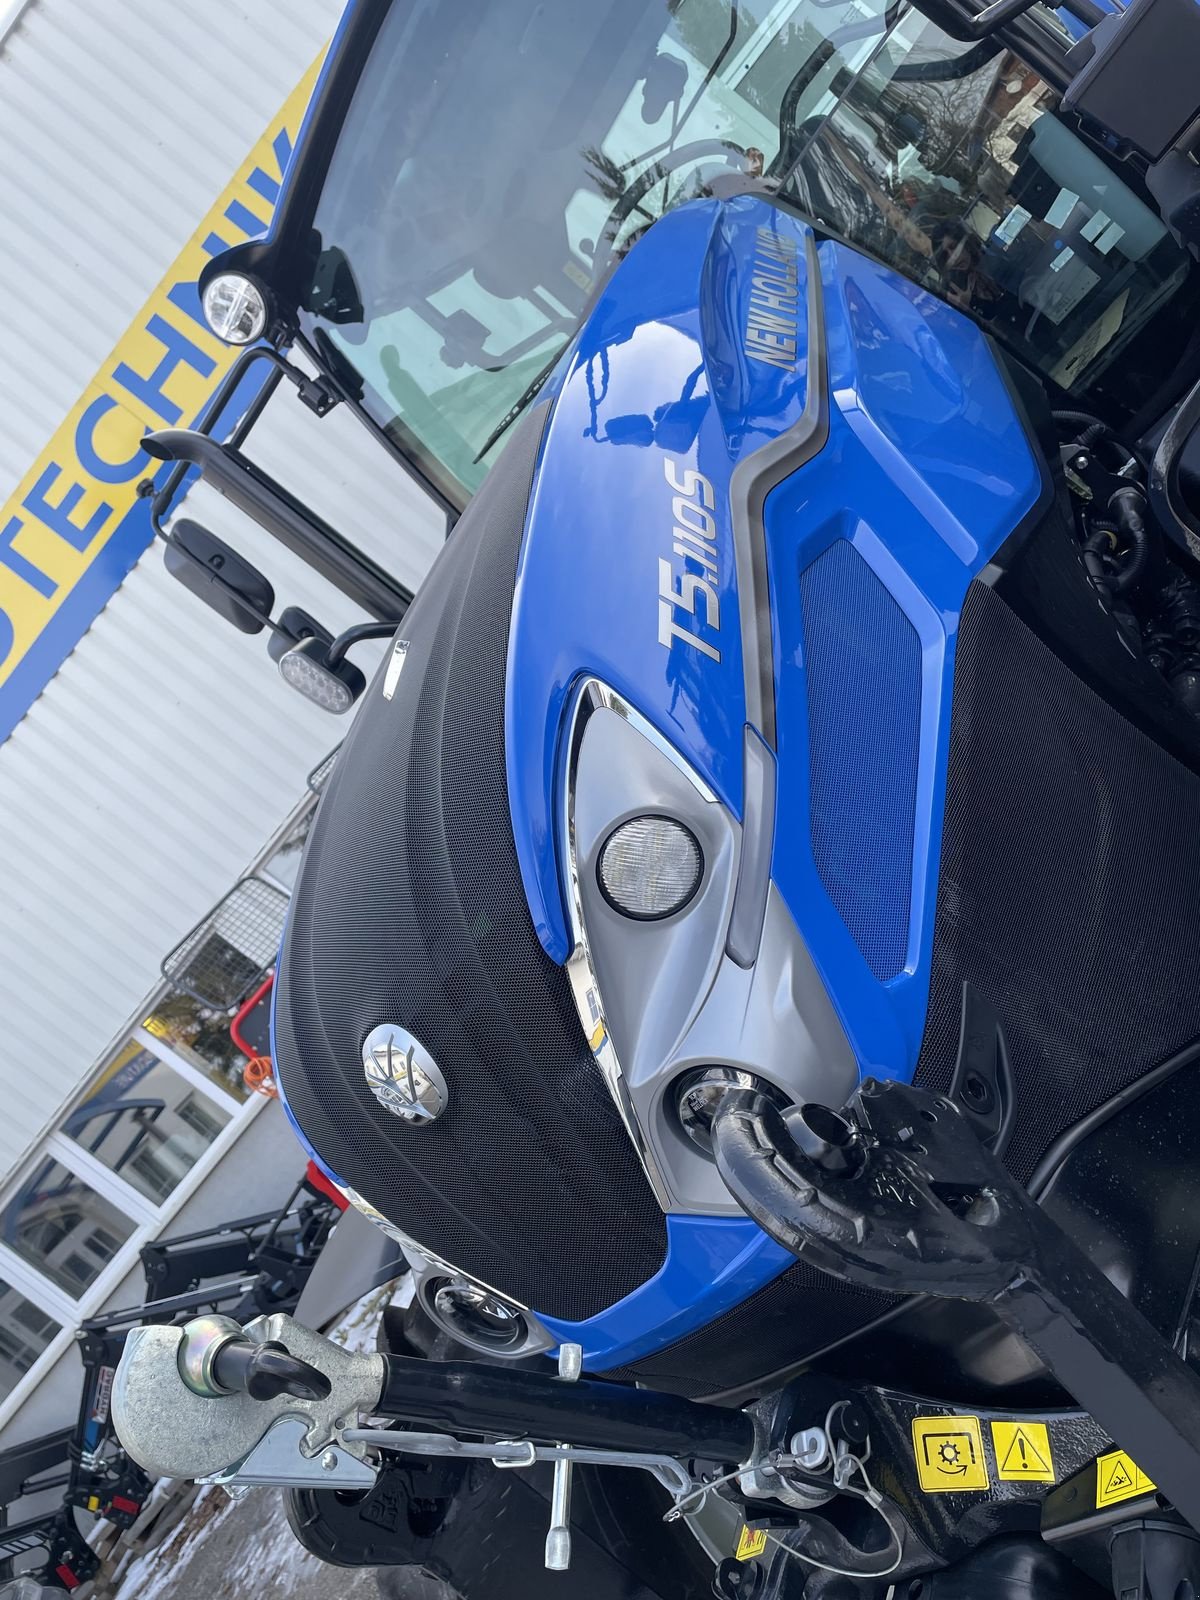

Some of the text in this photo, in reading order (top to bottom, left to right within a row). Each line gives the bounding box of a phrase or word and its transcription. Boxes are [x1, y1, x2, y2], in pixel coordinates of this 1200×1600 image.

[0, 127, 294, 667] TECHI
[744, 227, 799, 373] NEW HOLLAND
[658, 457, 721, 664] T5.110S
